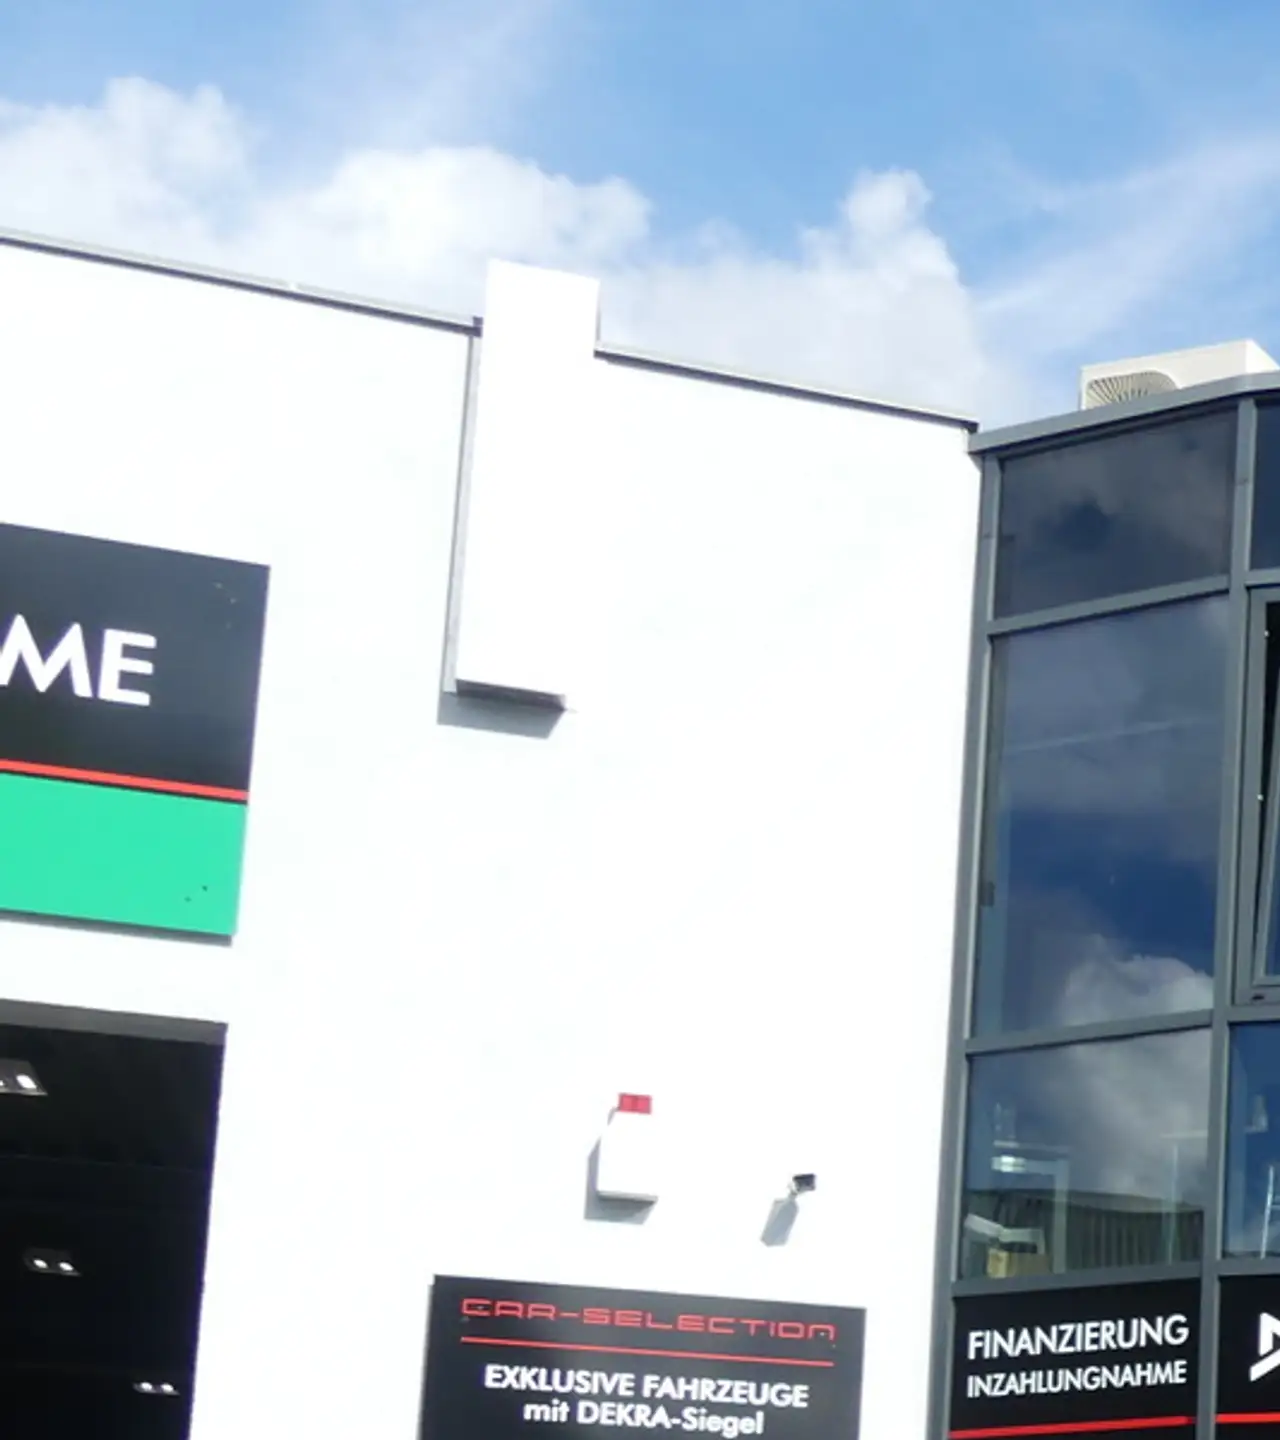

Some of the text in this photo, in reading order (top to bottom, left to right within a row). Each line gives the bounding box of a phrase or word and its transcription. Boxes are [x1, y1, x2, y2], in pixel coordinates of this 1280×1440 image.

[460, 1297, 836, 1341] CAR-SELECTION
[967, 1313, 1190, 1361] FINANZIERUNG
[484, 1364, 810, 1409] EXKLUSIVE FAHRZEUGE
[965, 1360, 1187, 1399] INZAHLUNGNAHME
[523, 1399, 765, 1440] mit DEKRA-Siegel
